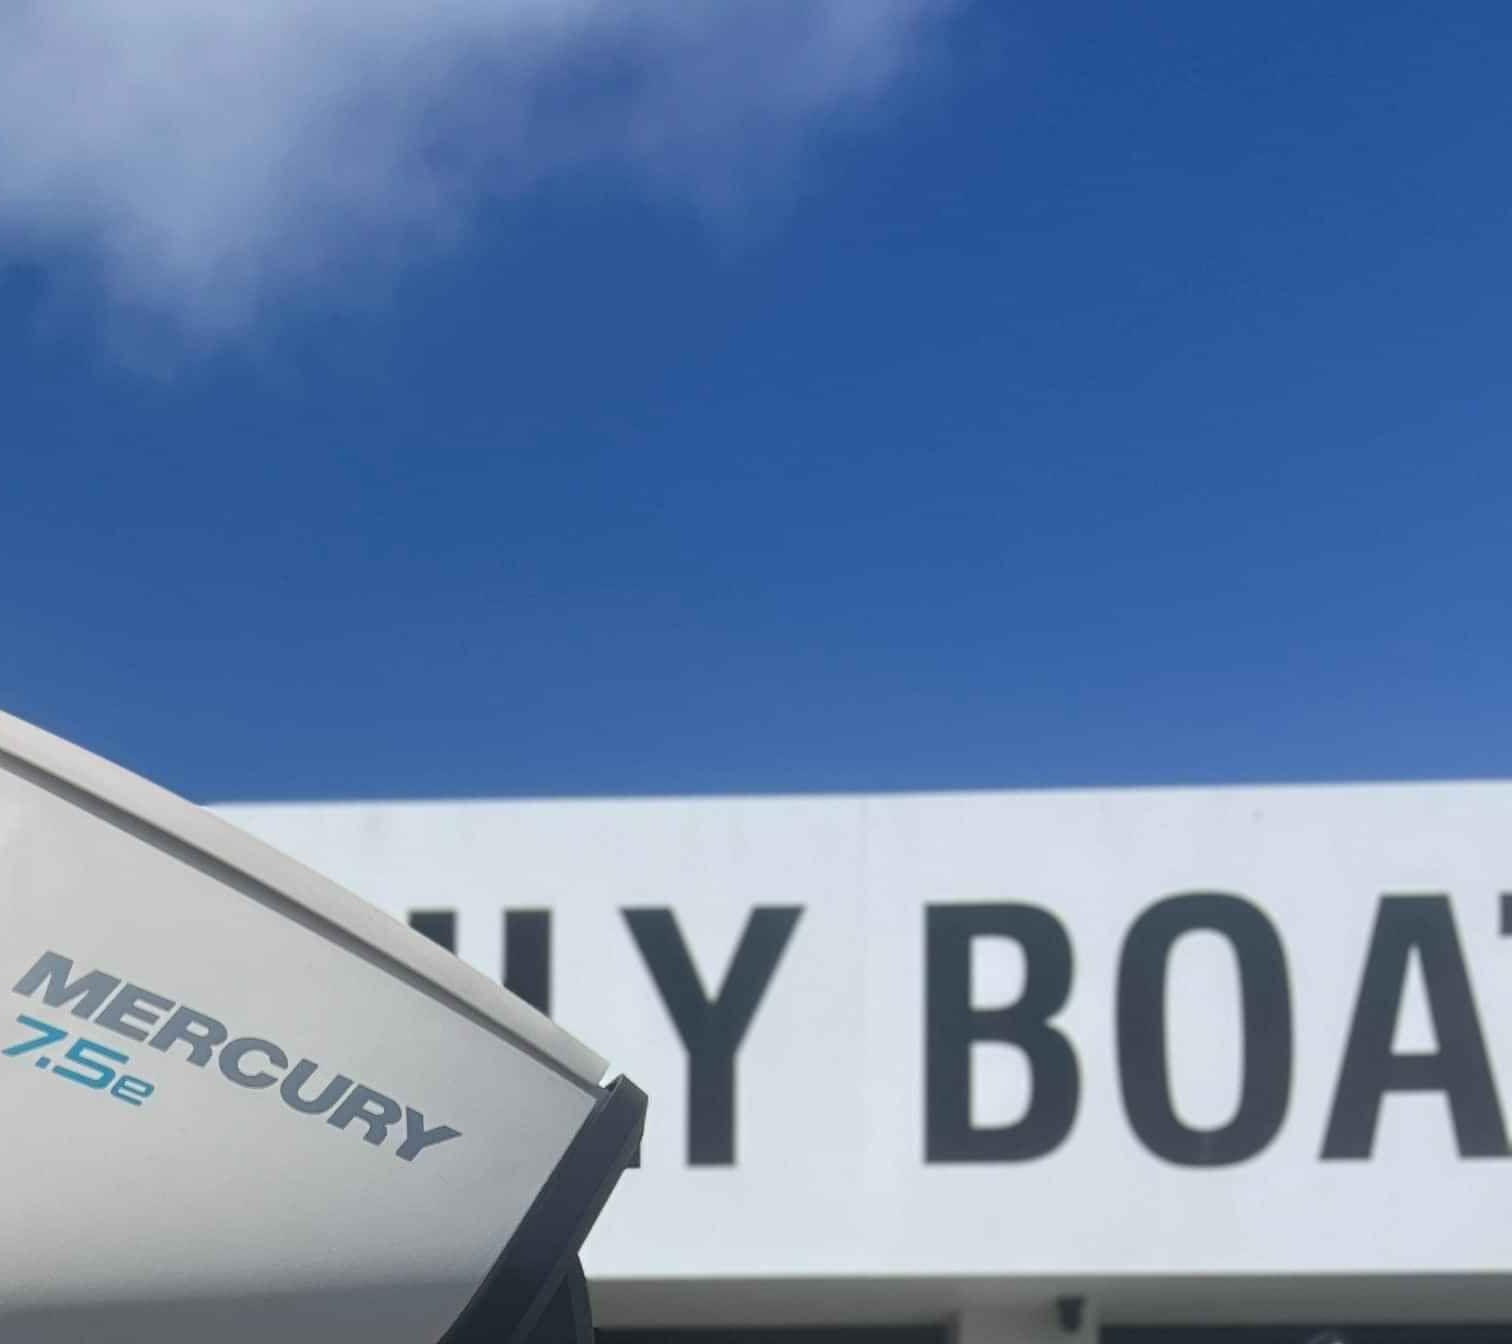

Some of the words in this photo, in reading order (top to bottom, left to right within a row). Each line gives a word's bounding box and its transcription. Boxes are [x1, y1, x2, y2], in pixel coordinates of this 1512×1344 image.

[0, 1013, 156, 1108] 7.5e
[11, 949, 463, 1162] MERCURY
[922, 889, 1512, 1168] BOA
